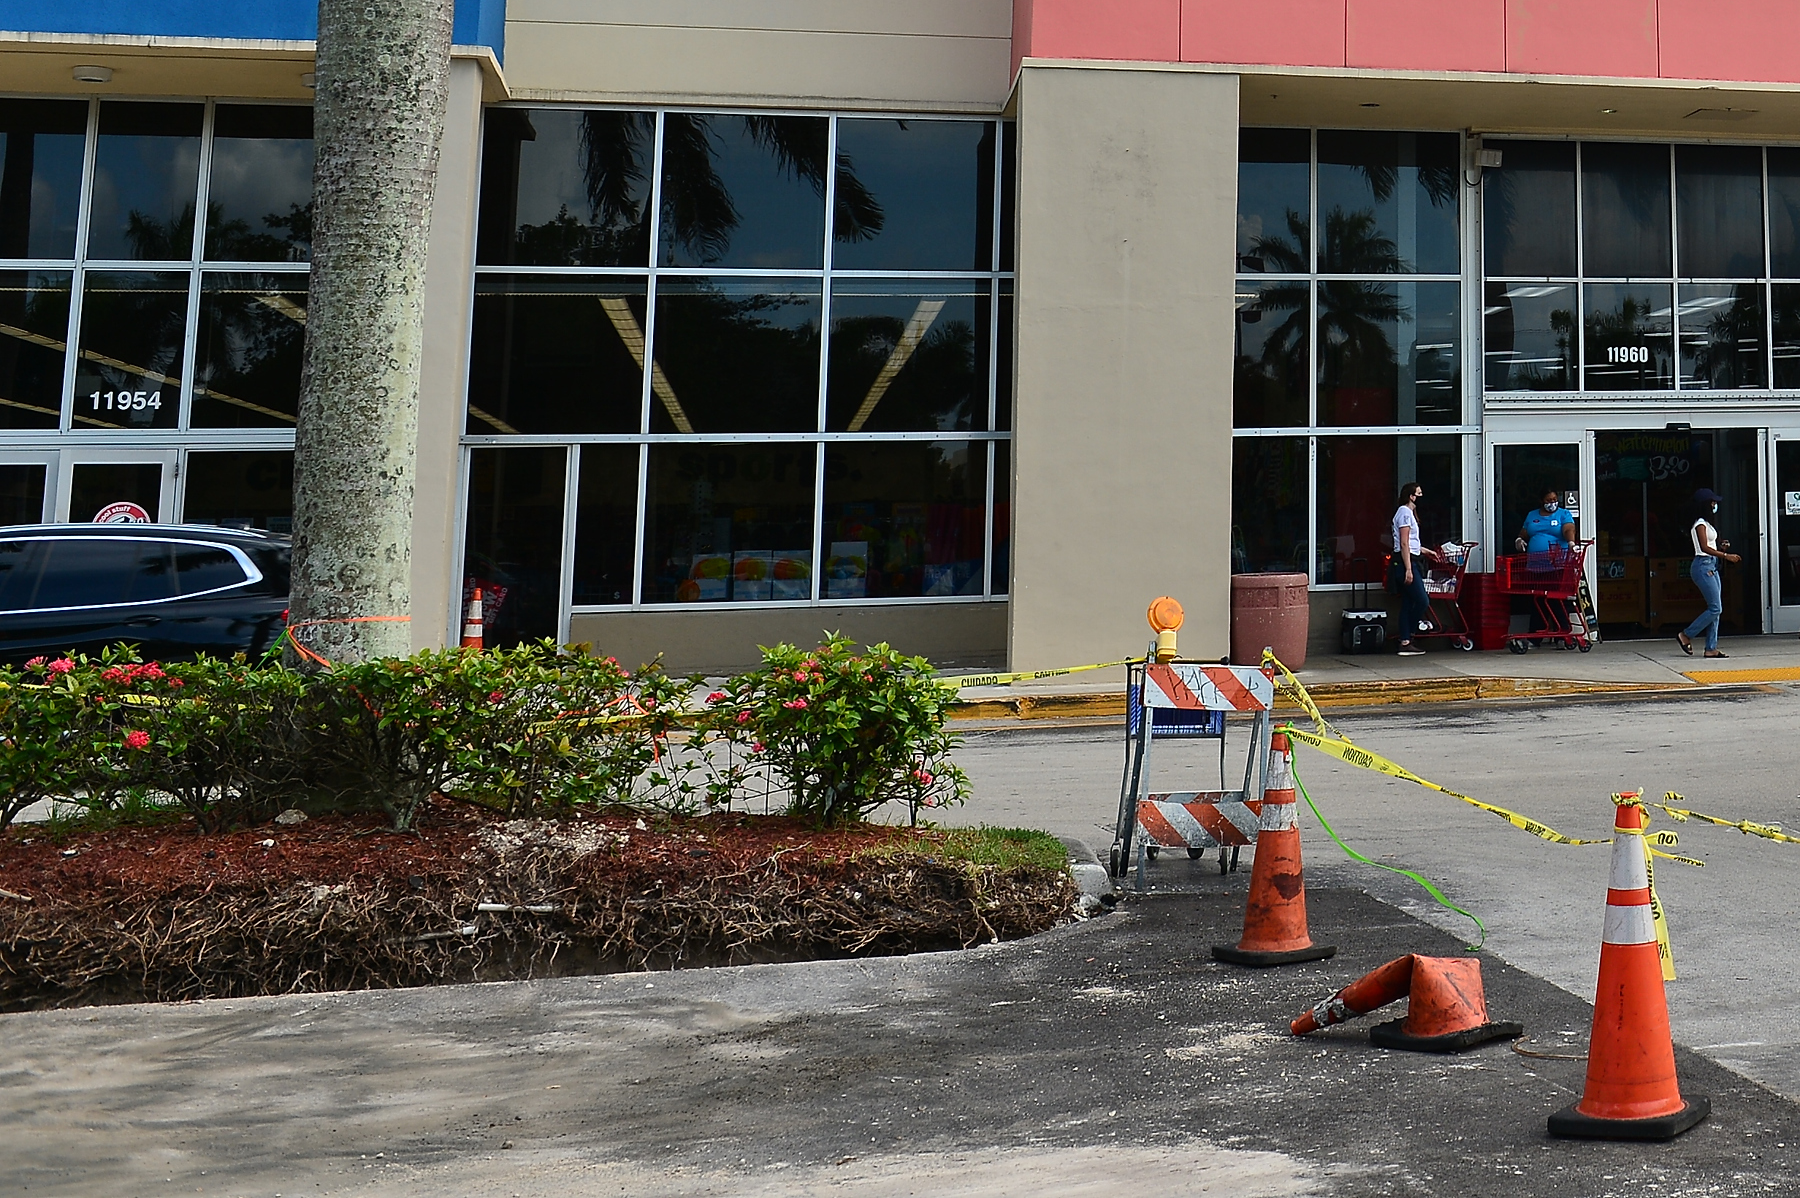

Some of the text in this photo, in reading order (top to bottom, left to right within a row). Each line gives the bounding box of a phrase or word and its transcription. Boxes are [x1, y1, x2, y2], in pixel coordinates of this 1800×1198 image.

[1606, 346, 1649, 363] 11960
[89, 390, 162, 411] 11954
[961, 675, 998, 688] CUIDADO
